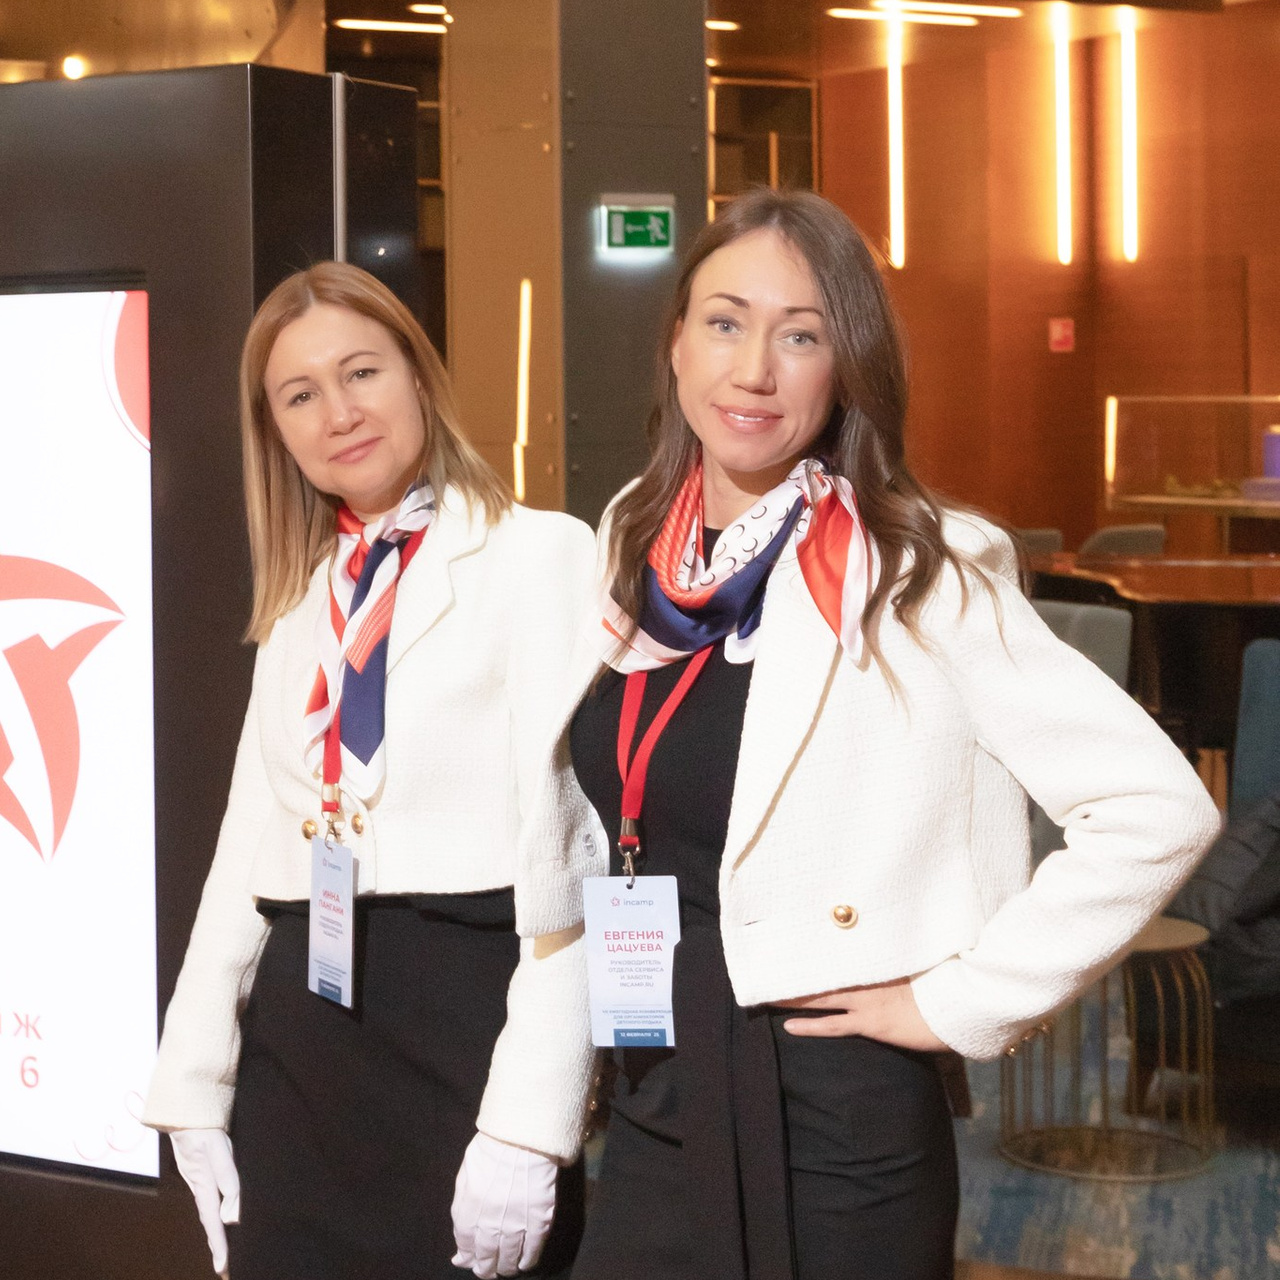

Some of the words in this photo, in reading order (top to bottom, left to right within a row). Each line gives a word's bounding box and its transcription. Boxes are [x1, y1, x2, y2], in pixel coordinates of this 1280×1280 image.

[624, 898, 654, 907] incamp
[604, 931, 664, 941] ЕВГЕНИЯ
[607, 942, 663, 954] ЦАЦУЕВА
[19, 1055, 41, 1089] 6
